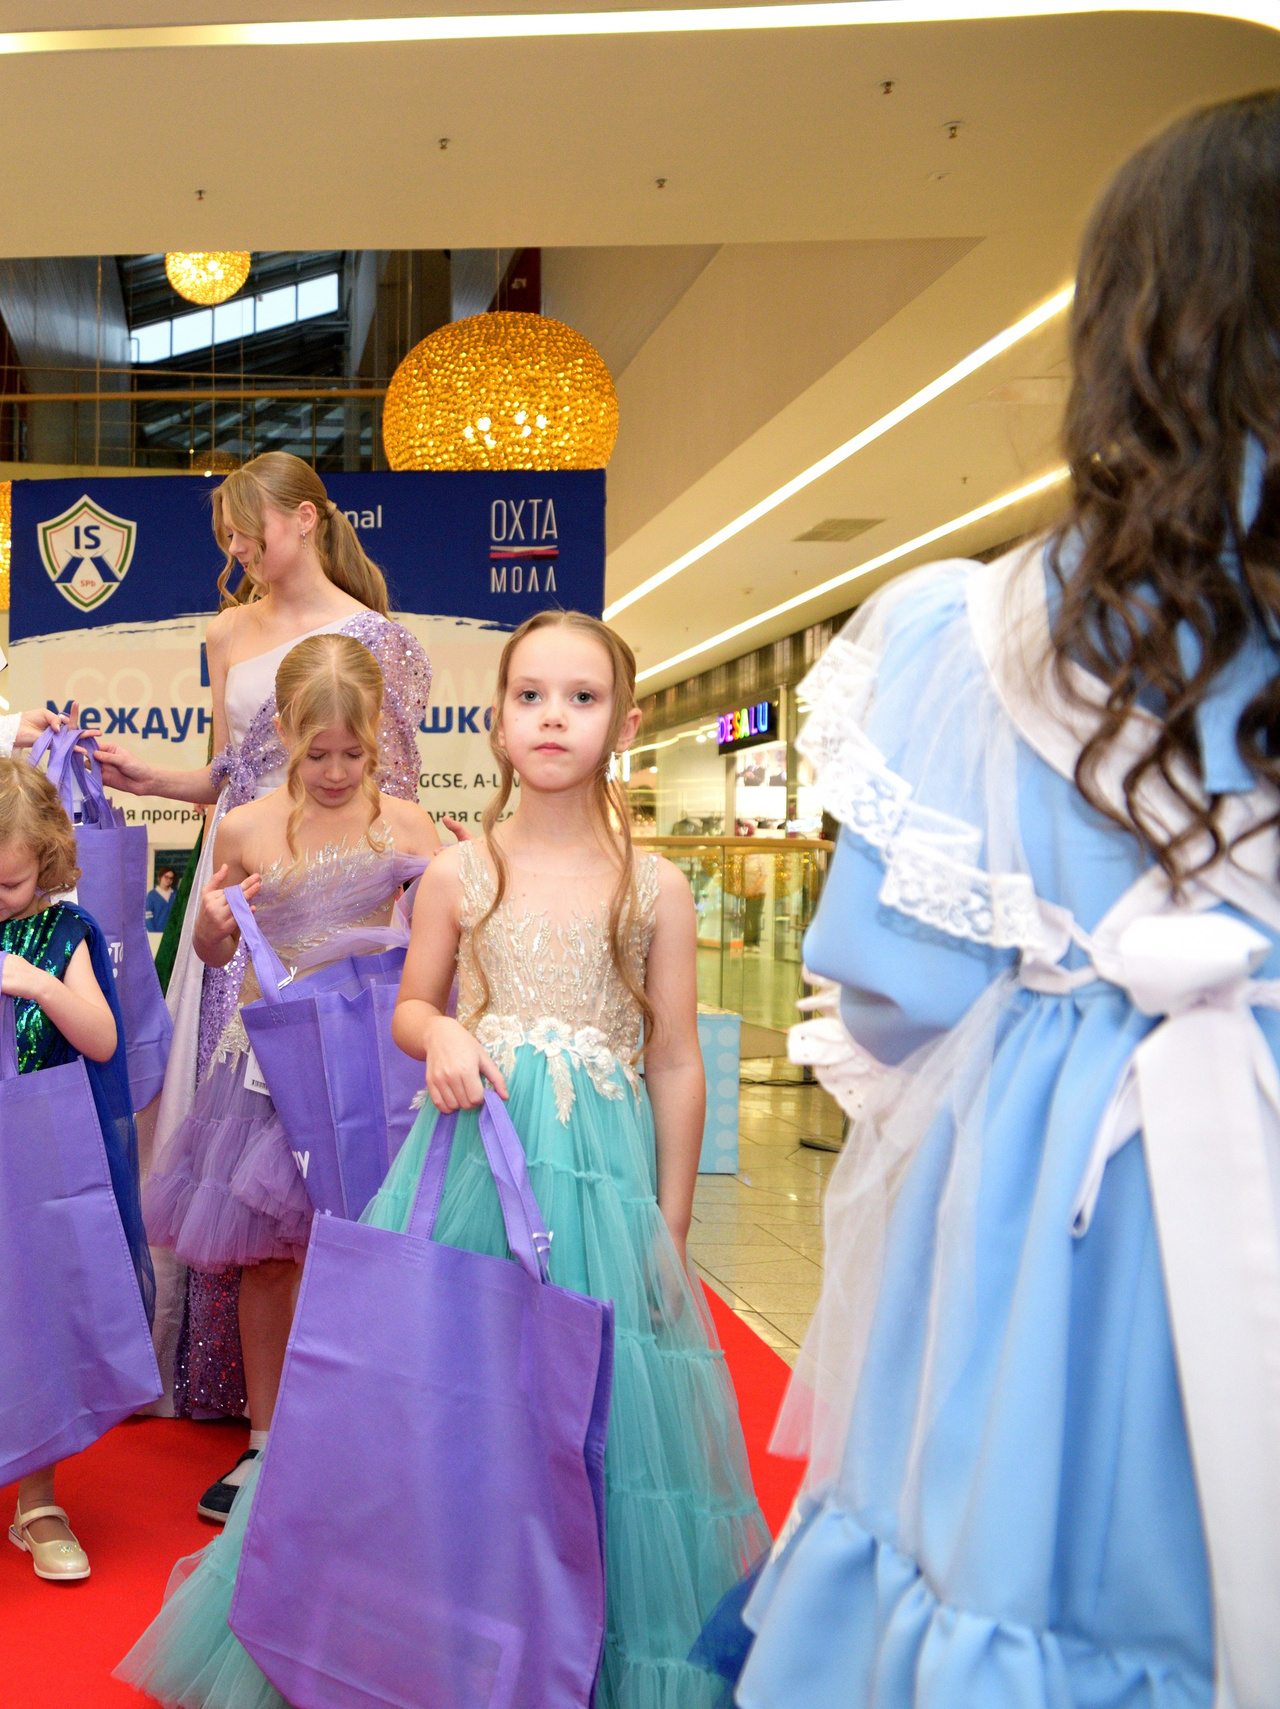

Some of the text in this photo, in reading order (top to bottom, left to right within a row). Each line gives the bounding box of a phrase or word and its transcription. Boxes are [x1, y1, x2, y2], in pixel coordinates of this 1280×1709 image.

[74, 525, 101, 549] IS
[491, 499, 558, 541] ОХТА
[491, 566, 557, 593] МОЛЛ
[717, 701, 769, 744] DESALU
